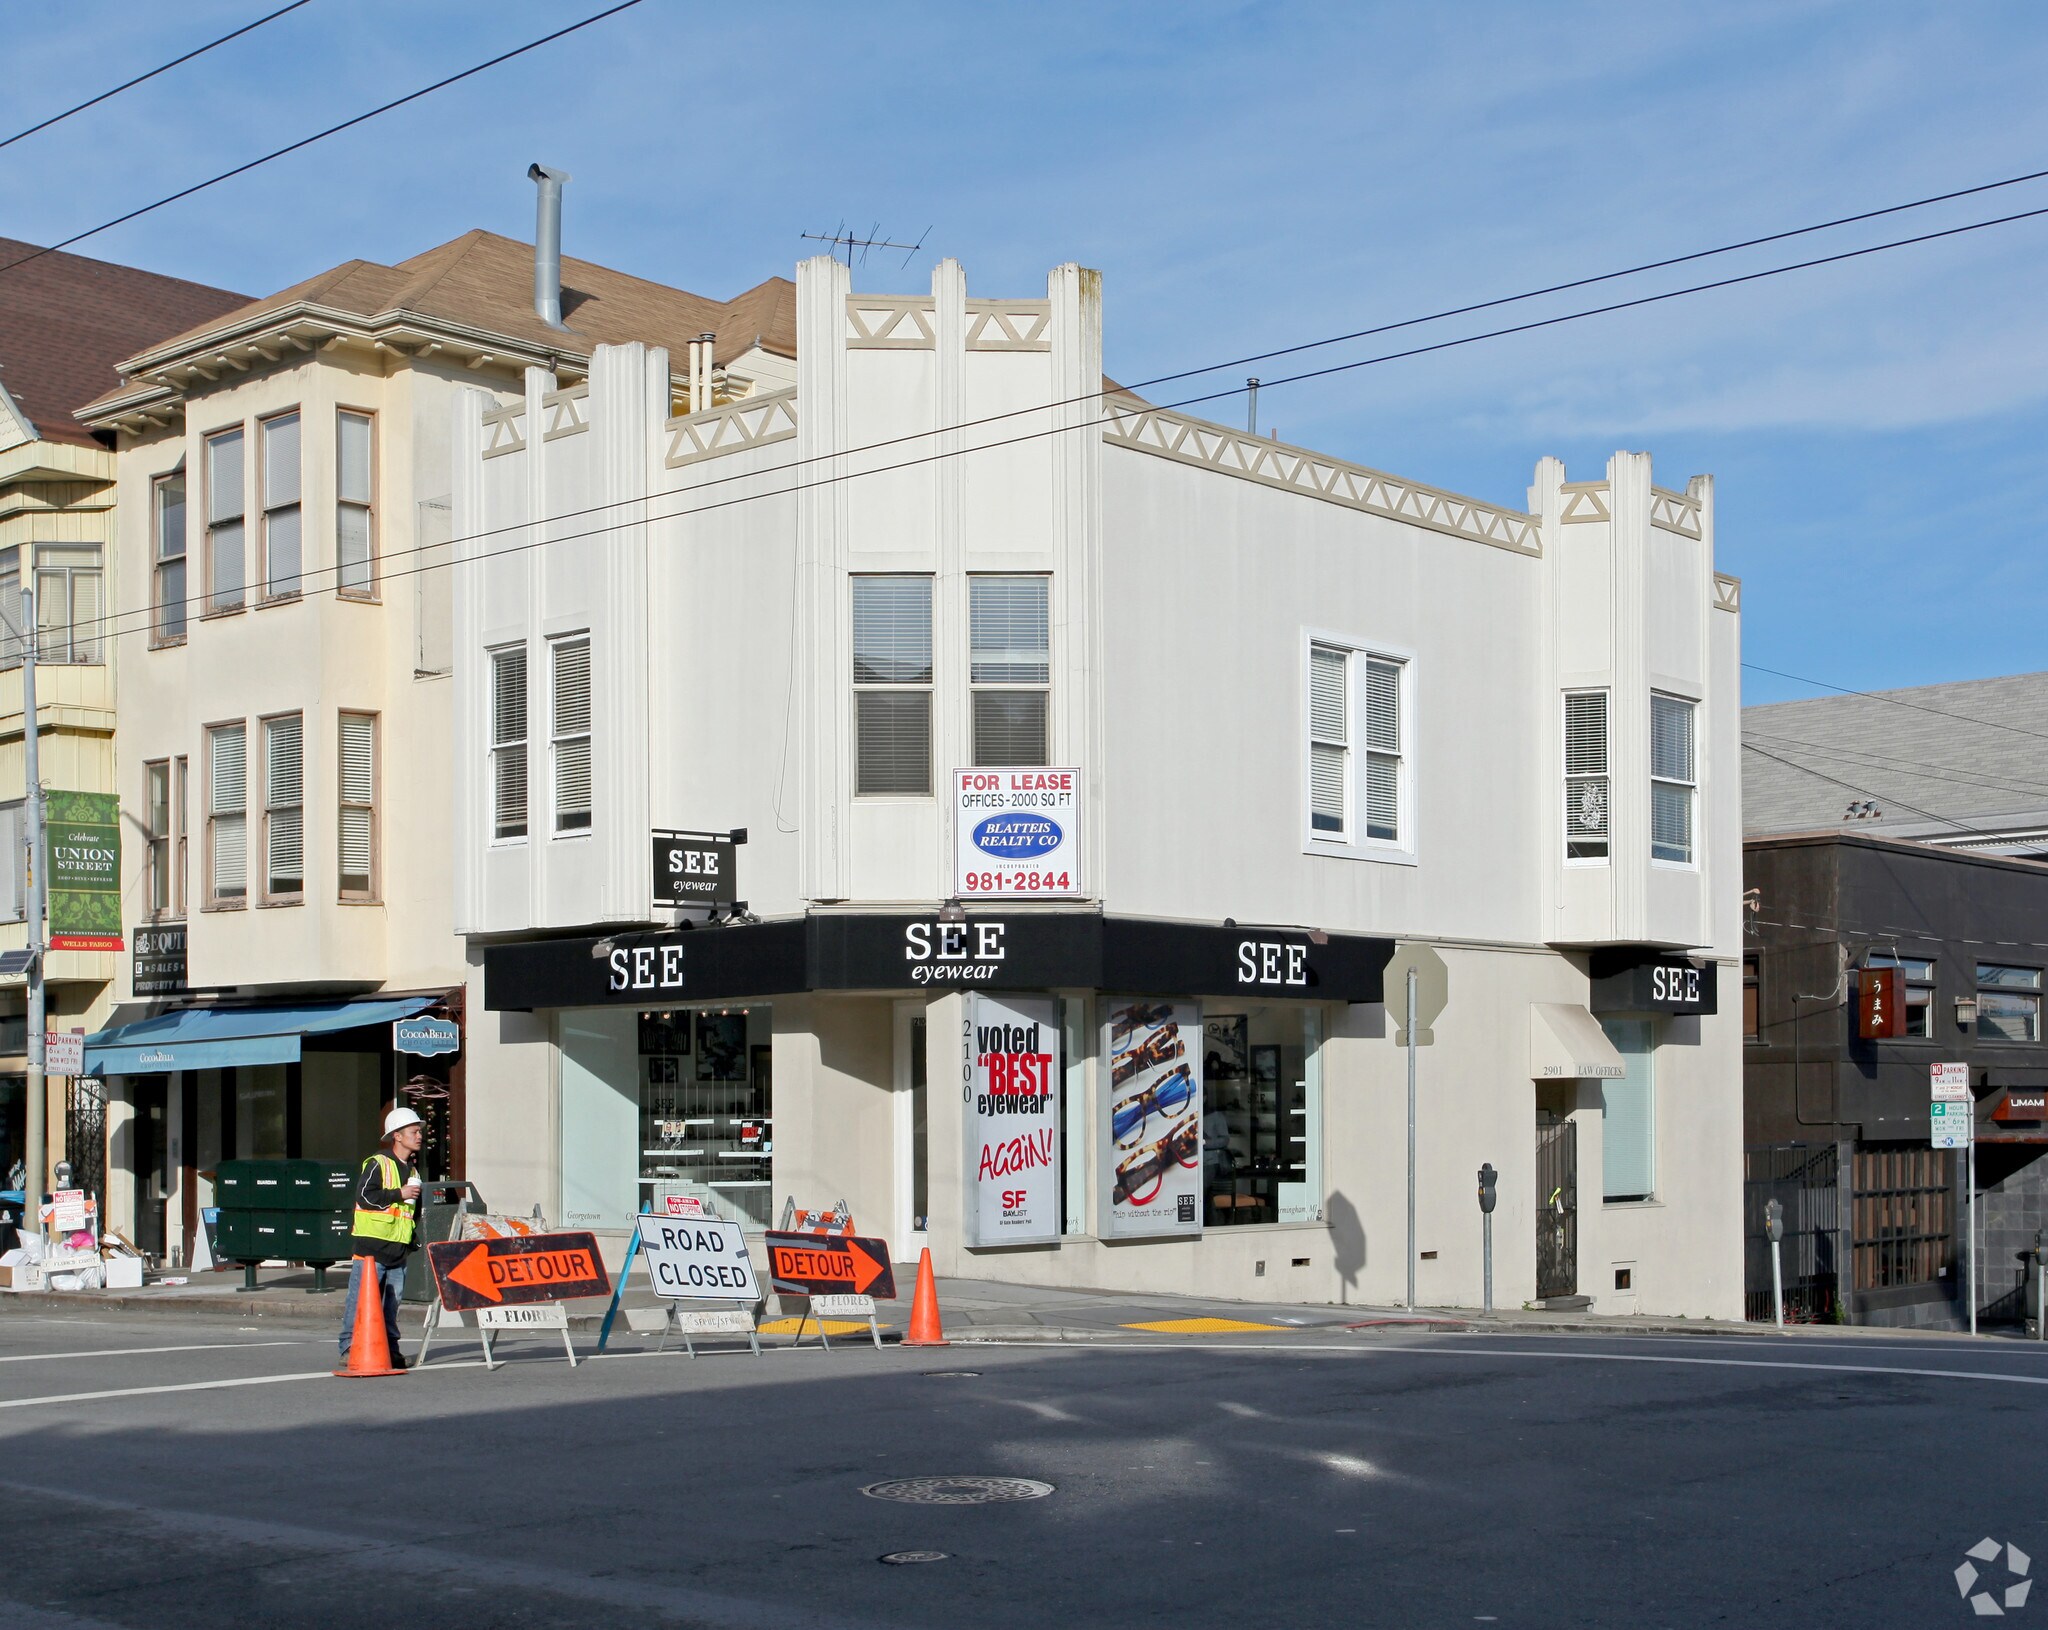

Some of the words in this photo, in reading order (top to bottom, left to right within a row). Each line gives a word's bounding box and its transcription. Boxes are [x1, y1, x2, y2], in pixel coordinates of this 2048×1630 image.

[962, 775, 999, 790] FOR
[1011, 774, 1072, 790] LEASE
[1041, 793, 1056, 806] SQ
[1059, 793, 1071, 806] FT
[985, 822, 1051, 834] BLATTEIS
[68, 833, 100, 842] Celebrate
[980, 836, 1034, 847] REALTY
[1038, 835, 1058, 846] CO
[54, 847, 115, 861] UNION
[57, 861, 113, 871] STREET
[669, 849, 719, 875] SEE
[673, 879, 718, 893] eyewear
[965, 872, 1070, 891] 981-2844
[62, 940, 88, 949] WELLS
[89, 941, 113, 949] FARGO
[905, 923, 1005, 960] SEE
[151, 962, 179, 973] SALES
[610, 945, 683, 990] SEE
[1238, 941, 1307, 985] SEE
[911, 964, 999, 985] eyewear
[135, 980, 174, 991] PROPERTY
[1653, 966, 1700, 1002] SEE
[1871, 980, 1884, 1026] うまみ
[46, 1033, 57, 1044] NO
[58, 1036, 82, 1045] PARKING
[977, 1022, 1039, 1054] voted
[963, 1020, 971, 1103] 2100
[1543, 1066, 1563, 1076] 2901
[1578, 1065, 1594, 1076] LAW
[1595, 1066, 1622, 1076] OFFICES
[1932, 1064, 1942, 1075] NO
[1934, 1104, 1942, 1114] 2
[2010, 1098, 2045, 1107] UMAMI
[1946, 1138, 1952, 1146] K
[1002, 1190, 1027, 1209] SF
[1179, 1196, 1194, 1206] SEE
[669, 1204, 680, 1213] NO
[1003, 1209, 1028, 1217] BAYLIST
[1128, 1208, 1150, 1218] without
[1152, 1208, 1162, 1217] the
[568, 1210, 600, 1221] Georgetown
[661, 1228, 725, 1253] ROAD
[487, 1253, 589, 1284] DETOUR
[780, 1252, 857, 1278] DETOUR
[658, 1263, 747, 1288] CLOSED
[820, 1296, 829, 1307] J.
[831, 1296, 870, 1306] FLORES
[486, 1311, 498, 1323] J.
[504, 1309, 560, 1323] FLORES
